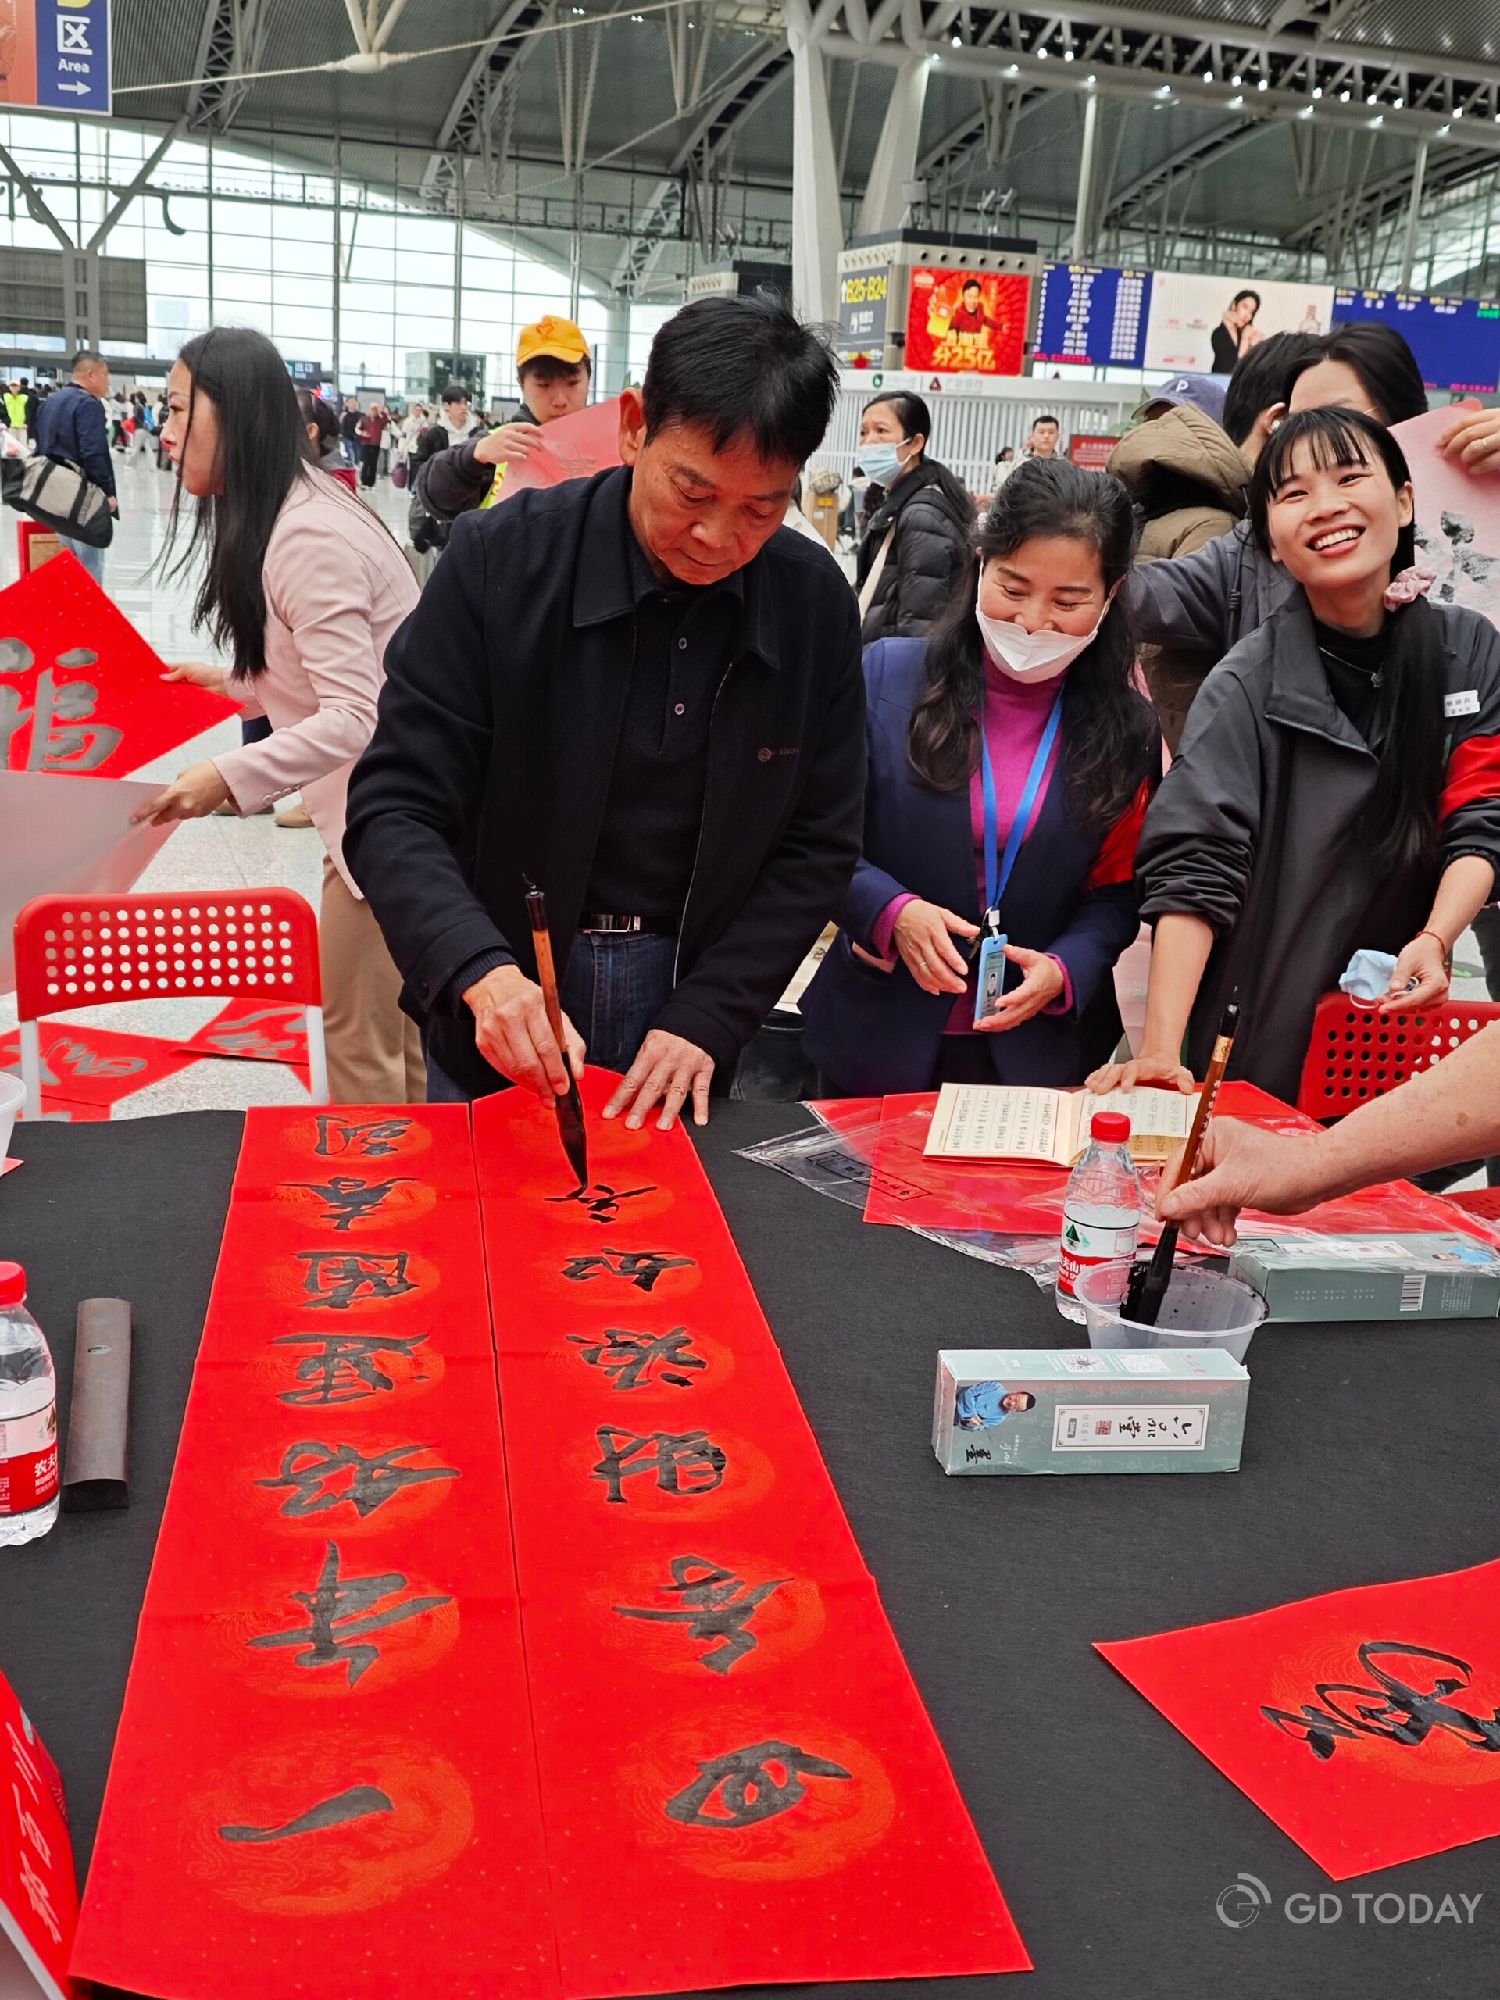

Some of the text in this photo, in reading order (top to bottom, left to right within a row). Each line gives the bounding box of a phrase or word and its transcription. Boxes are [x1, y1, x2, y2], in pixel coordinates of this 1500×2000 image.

[56, 14, 93, 55] 区
[58, 58, 91, 74] Area
[1175, 379, 1189, 392] P
[1119, 1414, 1193, 1440] 六品堂
[964, 1443, 992, 1465] 墨
